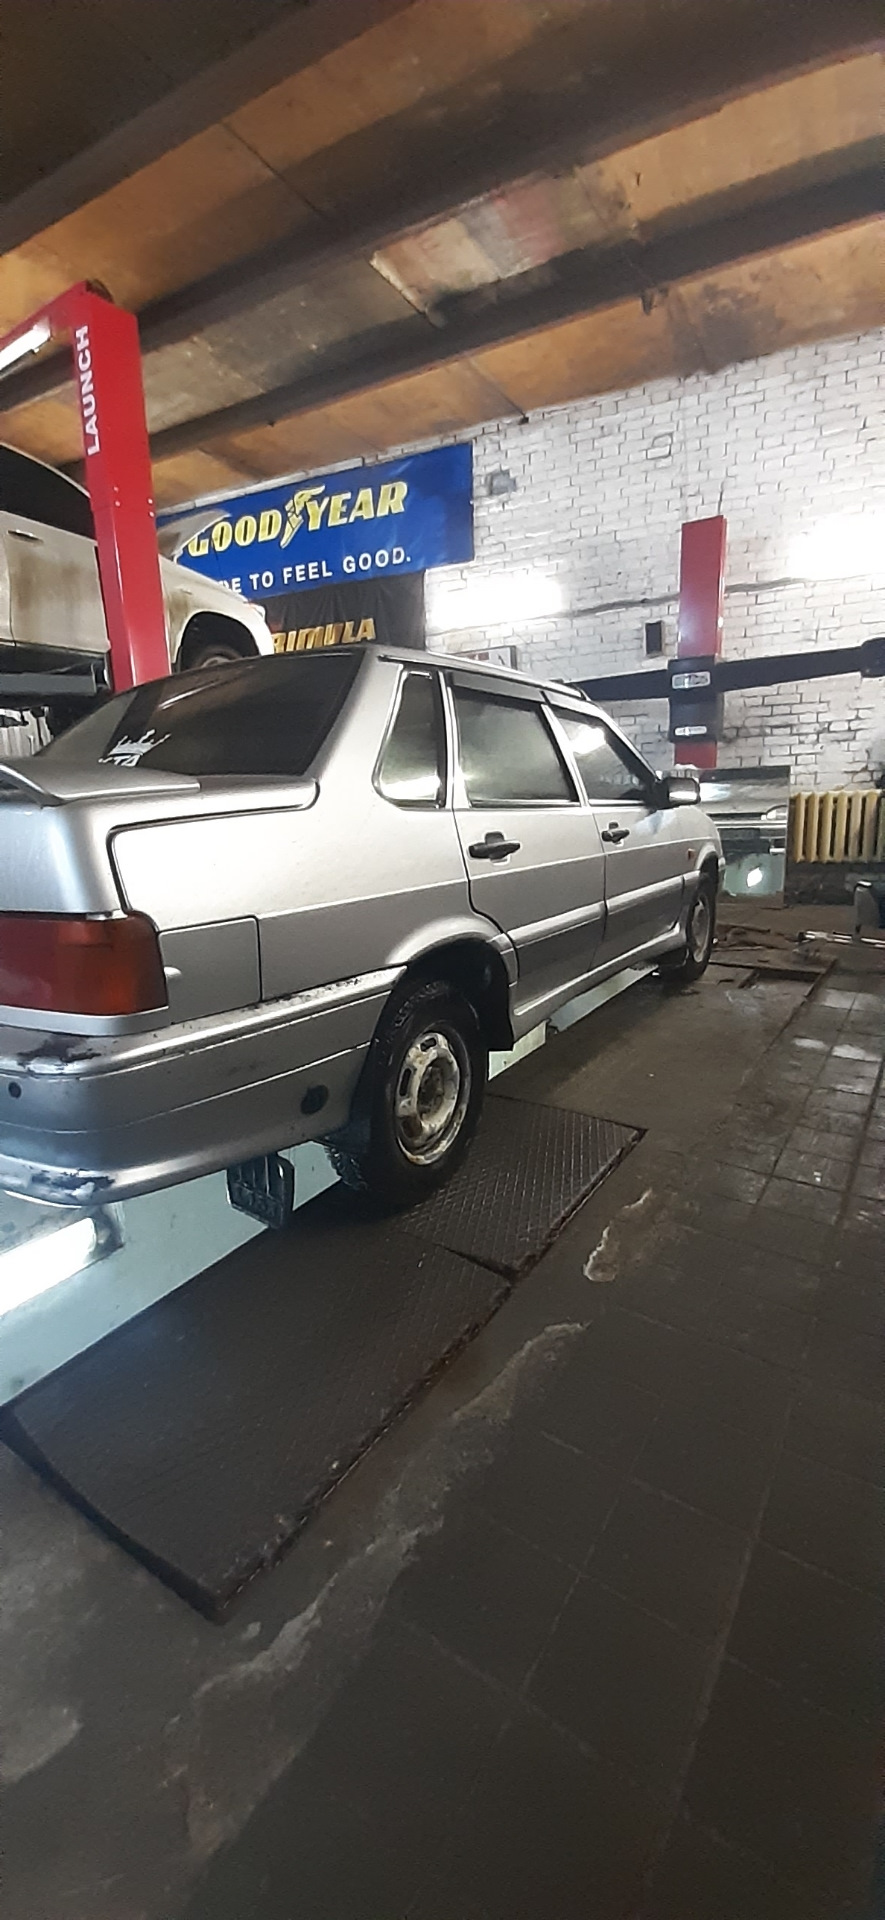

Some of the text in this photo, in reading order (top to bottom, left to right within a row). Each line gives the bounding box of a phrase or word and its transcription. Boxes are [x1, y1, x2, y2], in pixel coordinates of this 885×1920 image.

[75, 325, 100, 456] LAUNCH
[249, 570, 274, 590] TO
[282, 560, 333, 584] FEEL
[342, 546, 411, 573] GOOD.
[271, 618, 376, 654] RIMULA
